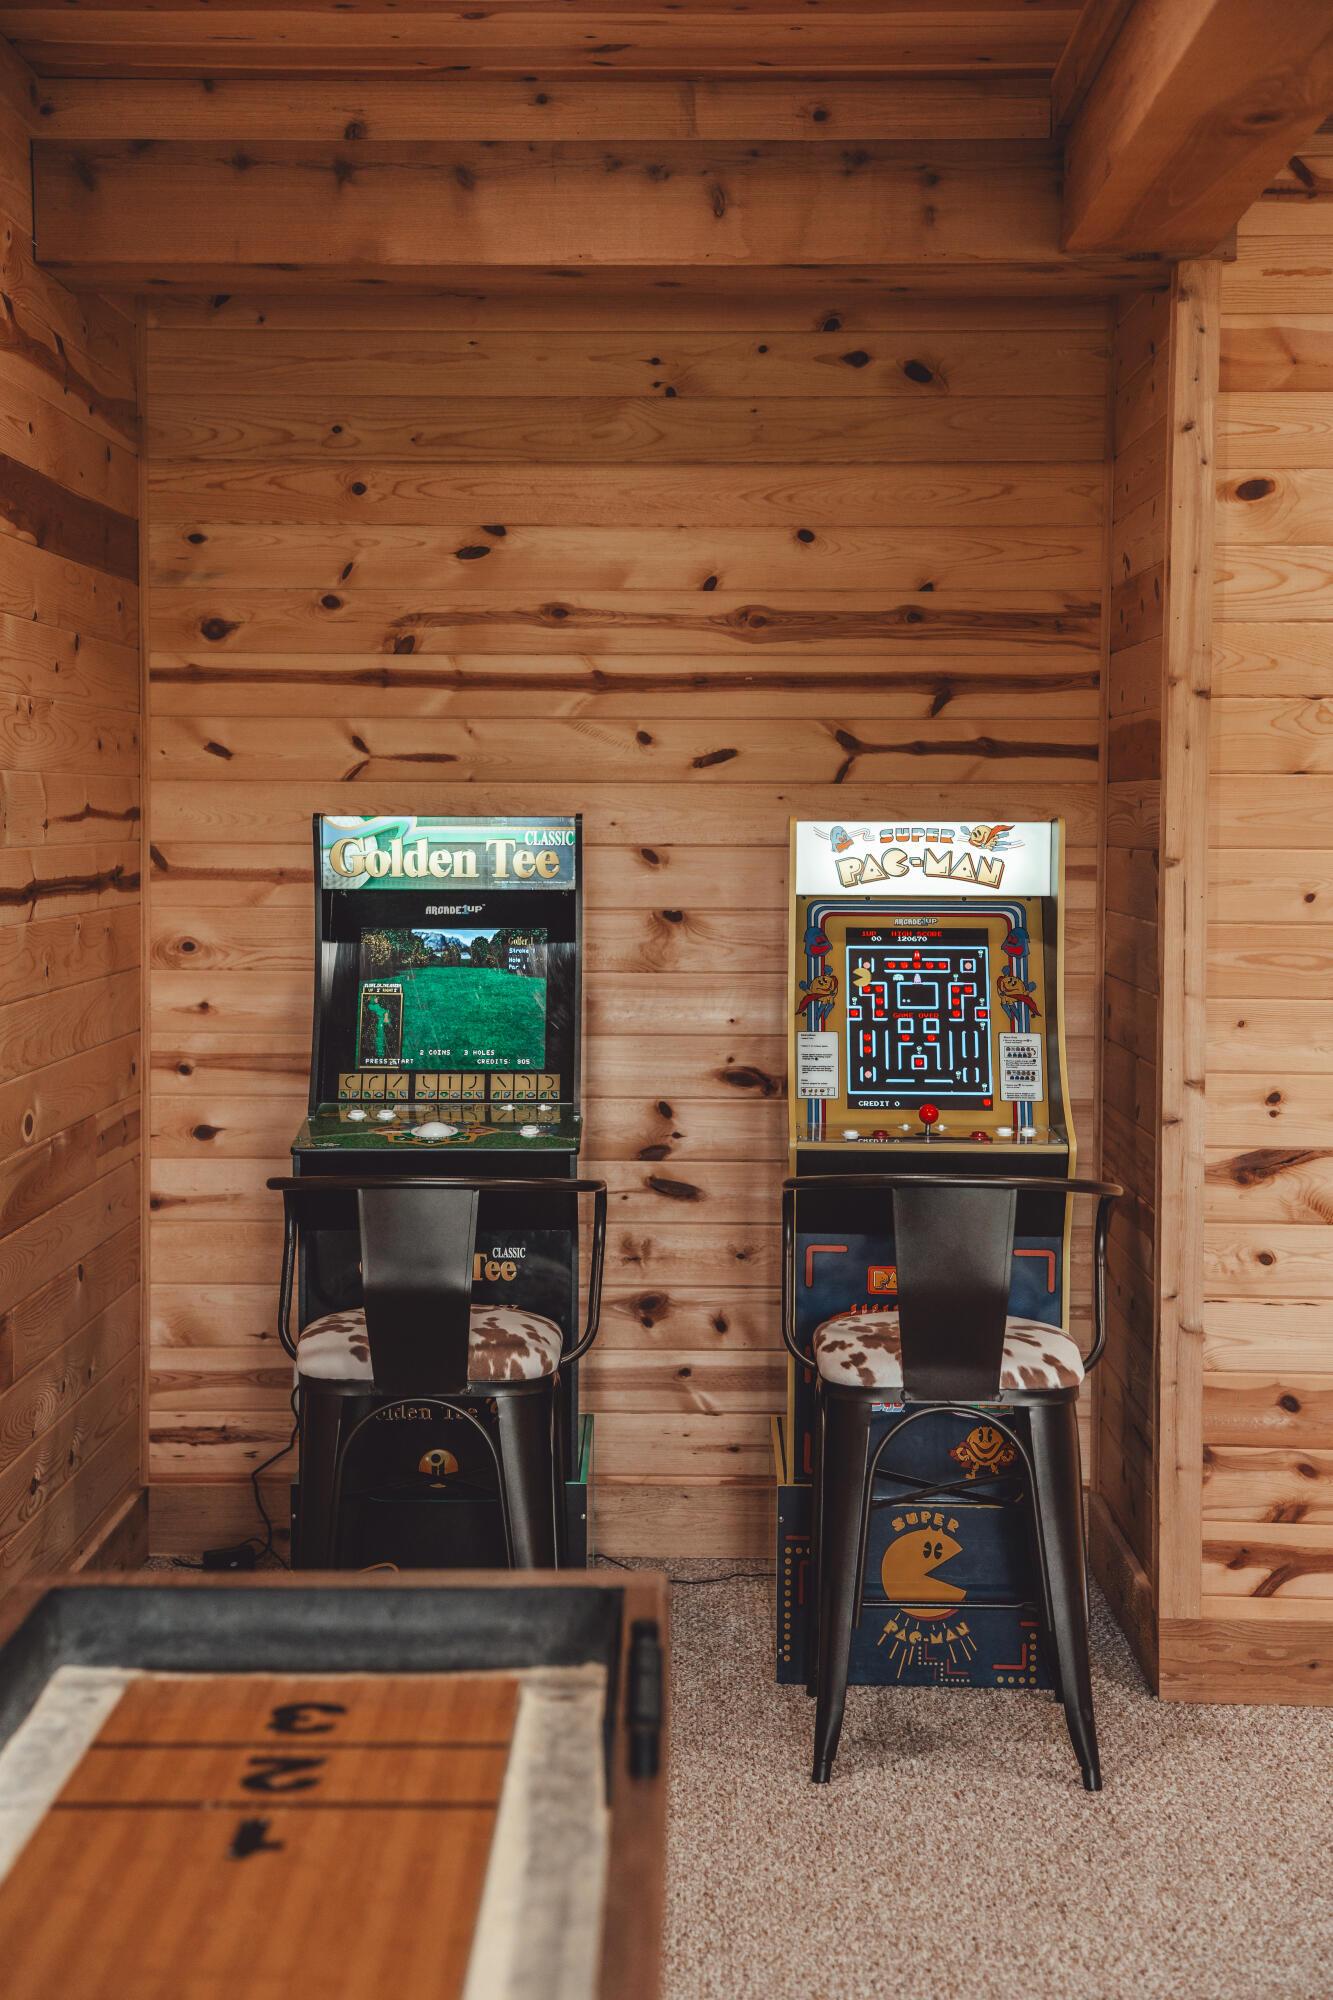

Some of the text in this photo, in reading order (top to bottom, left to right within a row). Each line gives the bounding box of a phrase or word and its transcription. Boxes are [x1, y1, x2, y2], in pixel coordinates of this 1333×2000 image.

[524, 830, 575, 846] CLASSIC
[880, 827, 955, 844] SUPER
[329, 836, 560, 879] Golden Tee
[835, 847, 1006, 889] PAC-MAN
[492, 1247, 526, 1258] CLASSIC
[891, 1510, 960, 1533] SUPER
[883, 1618, 970, 1645] PAC-MAN
[266, 1701, 347, 1736] 3
[241, 1756, 326, 1793] 2
